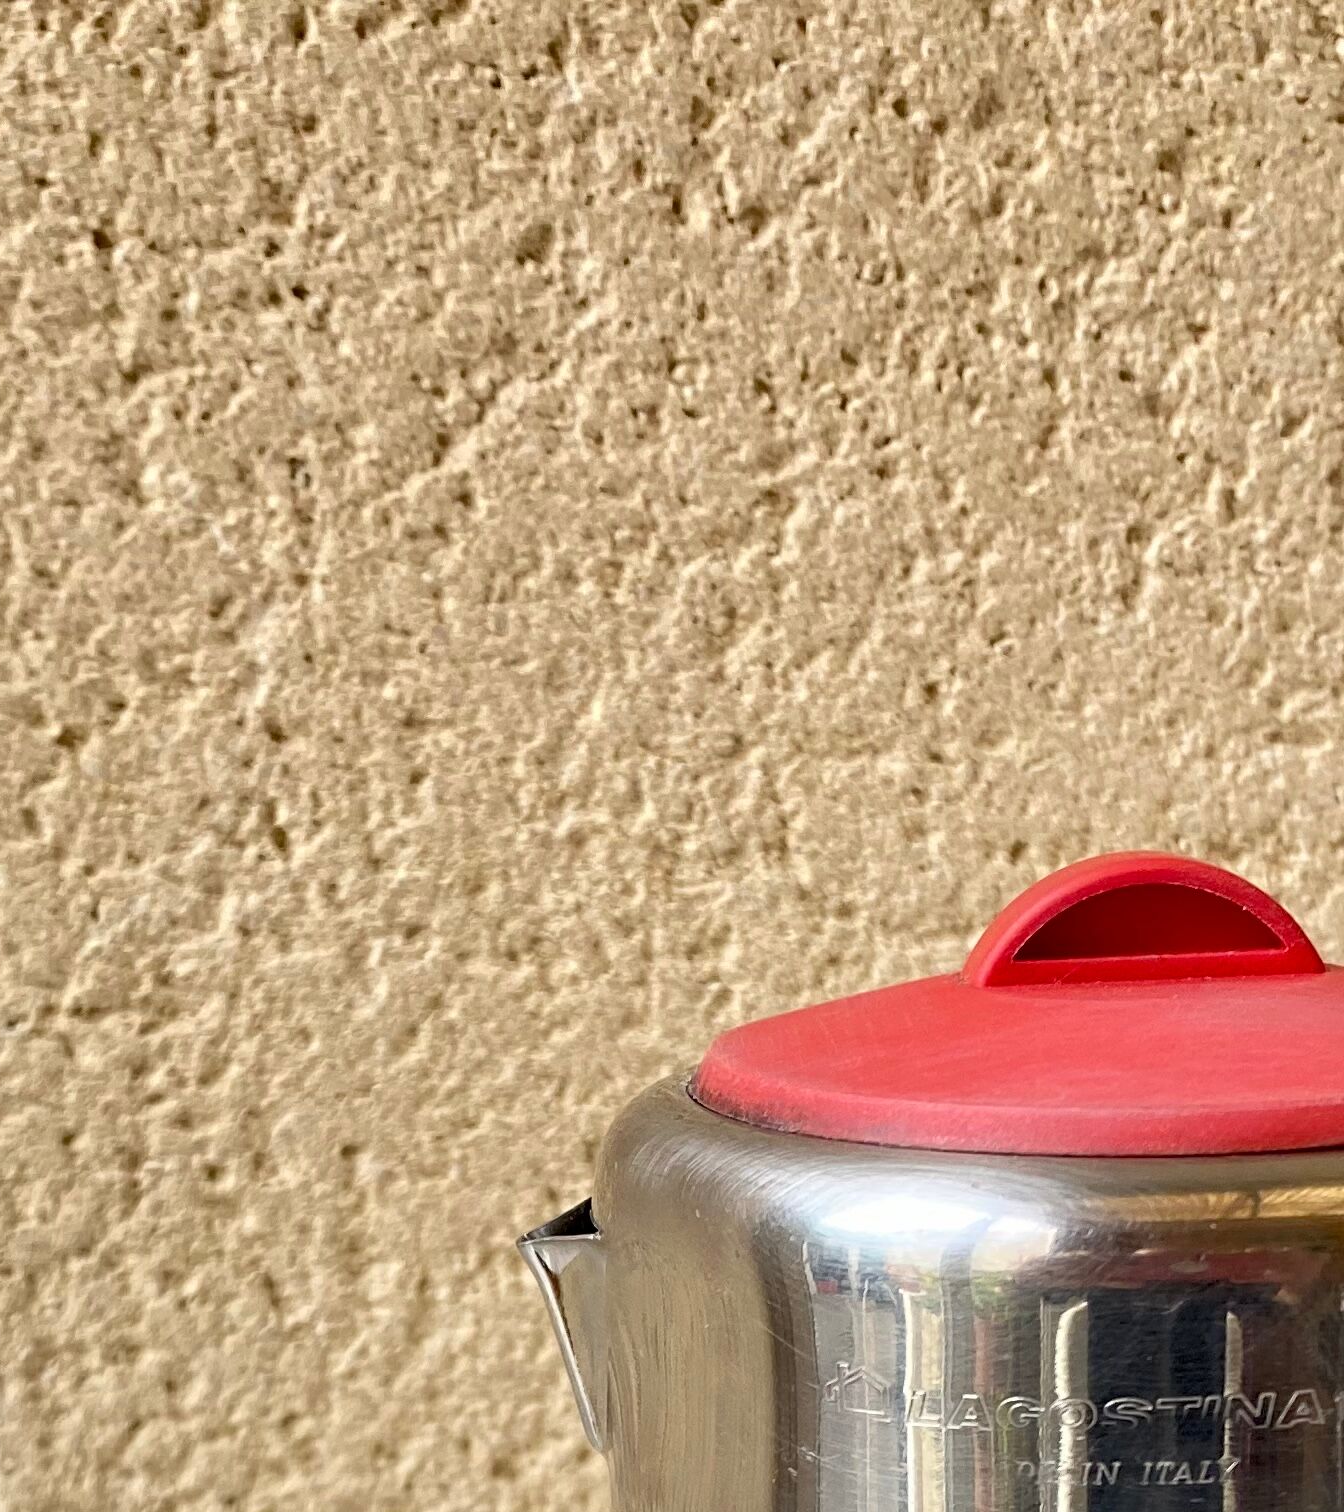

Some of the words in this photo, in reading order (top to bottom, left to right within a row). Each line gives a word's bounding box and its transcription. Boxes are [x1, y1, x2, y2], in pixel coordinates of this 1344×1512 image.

[904, 1389, 1326, 1430] LAGOSTINA
[1081, 1461, 1122, 1486] IN
[1139, 1457, 1240, 1486] ITALY
